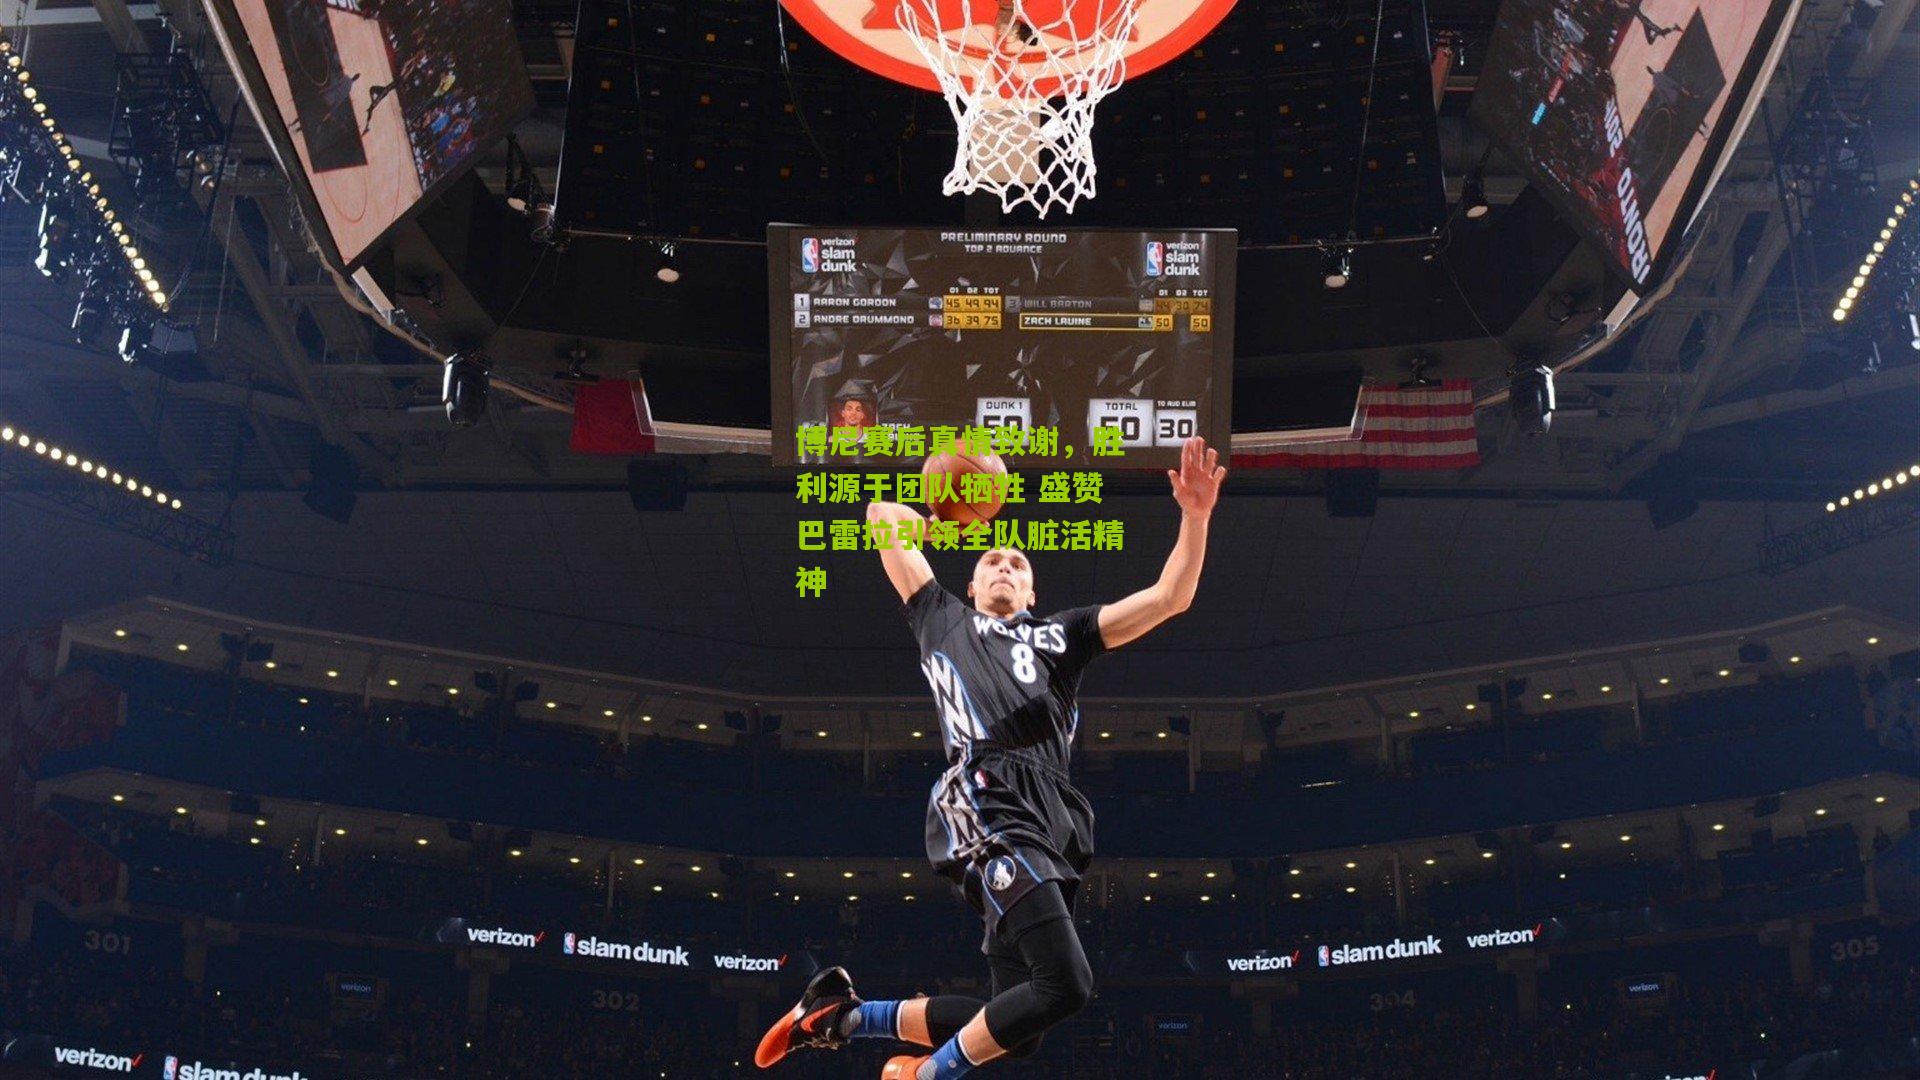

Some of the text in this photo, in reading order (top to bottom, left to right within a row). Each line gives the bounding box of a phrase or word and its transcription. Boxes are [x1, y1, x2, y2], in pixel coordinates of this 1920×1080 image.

[821, 237, 855, 246] verizon
[940, 232, 1067, 243] PRELIMINARY ROUND
[965, 244, 984, 253] TOP
[1166, 241, 1200, 250] verizon
[821, 246, 856, 259] slam
[1165, 250, 1200, 263] slam
[821, 260, 857, 272] dunk
[1165, 262, 1200, 276] dunk
[813, 298, 850, 307] AARON
[852, 298, 897, 307] GORDON
[946, 299, 960, 308] 45
[965, 299, 980, 308] 49
[983, 299, 999, 308] 94
[799, 315, 806, 324] 2
[813, 315, 850, 324] ANDRE
[852, 315, 915, 325] DRUMMOND
[965, 316, 980, 325] 39
[983, 316, 999, 326] 75
[1024, 316, 1052, 325] ZACH
[1156, 318, 1170, 327] 50
[1193, 318, 1208, 328] 50
[985, 401, 1016, 410] DUNK
[1105, 402, 1138, 411] TOTAL
[1159, 418, 1194, 439] 30
[1011, 643, 1036, 684] 8
[84, 930, 131, 955] 301
[467, 927, 536, 948] verizon
[1467, 928, 1535, 948] verizon
[577, 936, 690, 966] slam dunk
[1331, 935, 1443, 965] slam dunk
[1832, 936, 1879, 961] 305
[714, 954, 779, 971] verizon
[1227, 955, 1292, 971] verizon
[1629, 982, 1659, 992] verizon
[591, 989, 640, 1011] 302
[54, 1046, 132, 1072] verizon
